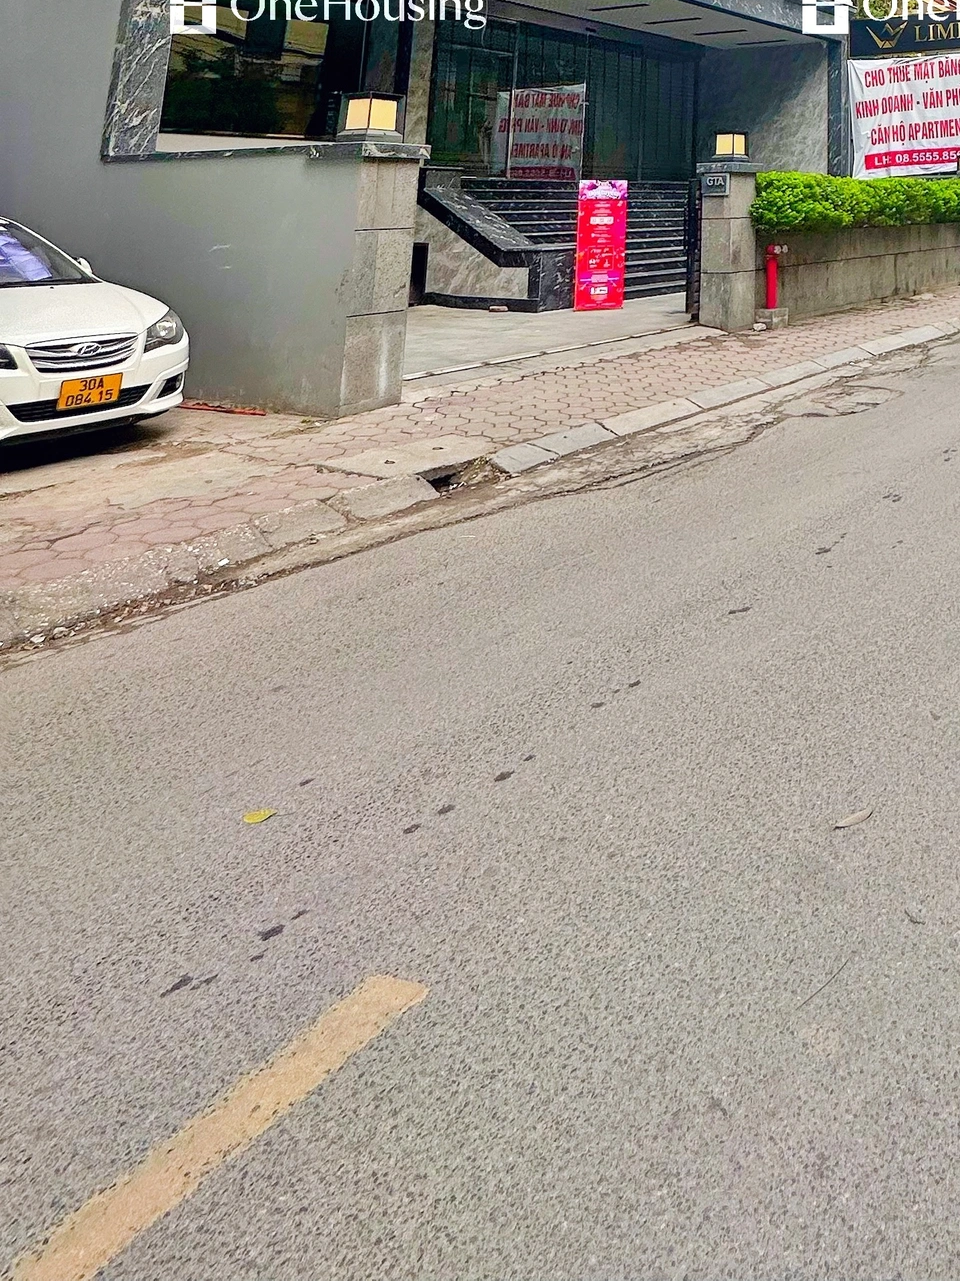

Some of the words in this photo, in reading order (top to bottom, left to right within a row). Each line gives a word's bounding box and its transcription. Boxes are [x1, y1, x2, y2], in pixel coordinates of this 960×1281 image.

[864, 68, 886, 89] CHO
[887, 61, 911, 84] THUÊ
[855, 98, 880, 120] KINH
[881, 93, 914, 115] DOANH
[922, 87, 944, 110] VĂN
[870, 123, 891, 146] CĂN
[892, 120, 906, 146] HỘ
[706, 176, 725, 186] GTA
[79, 377, 104, 392] 30A
[65, 388, 114, 407] 084.15
